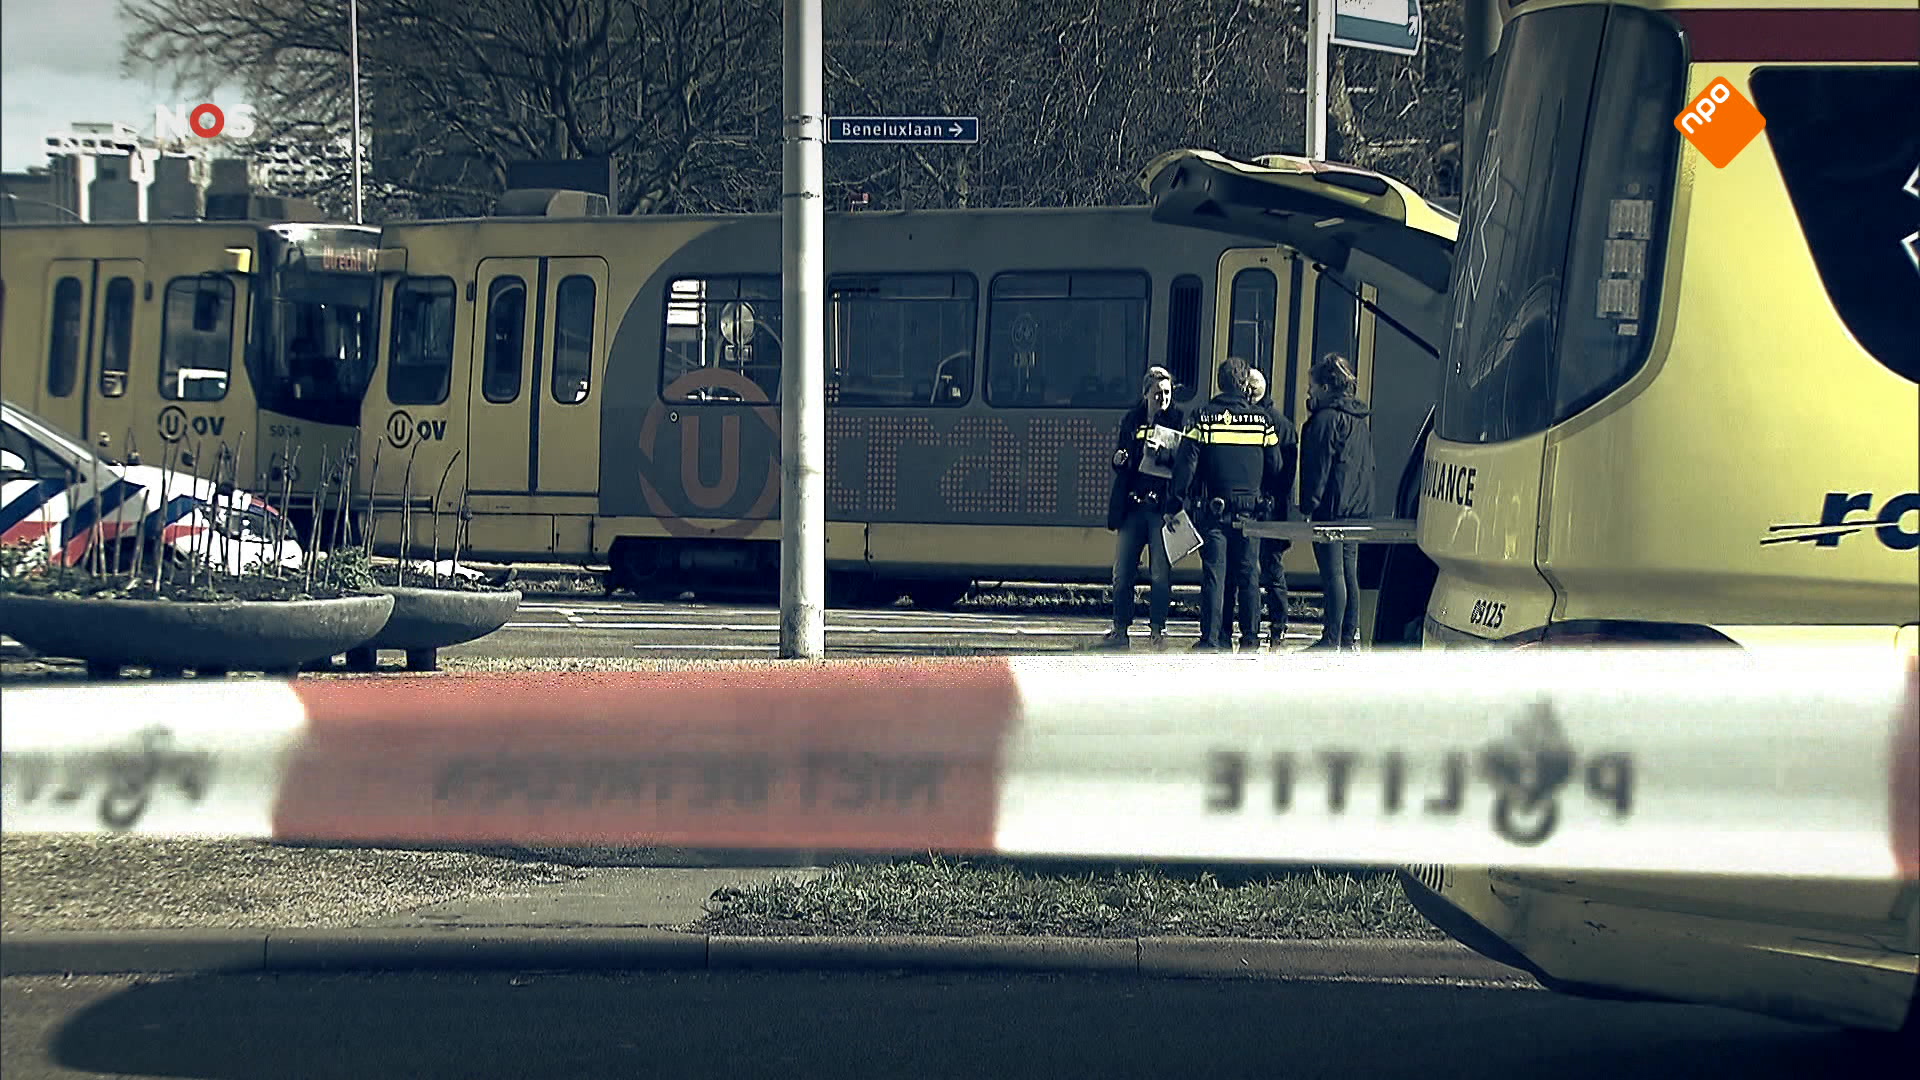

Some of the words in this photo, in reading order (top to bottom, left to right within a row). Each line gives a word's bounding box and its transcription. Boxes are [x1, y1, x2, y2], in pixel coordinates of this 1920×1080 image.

[842, 121, 942, 137] Beneluxlaan
[192, 416, 225, 436] OV
[416, 420, 447, 441] OV
